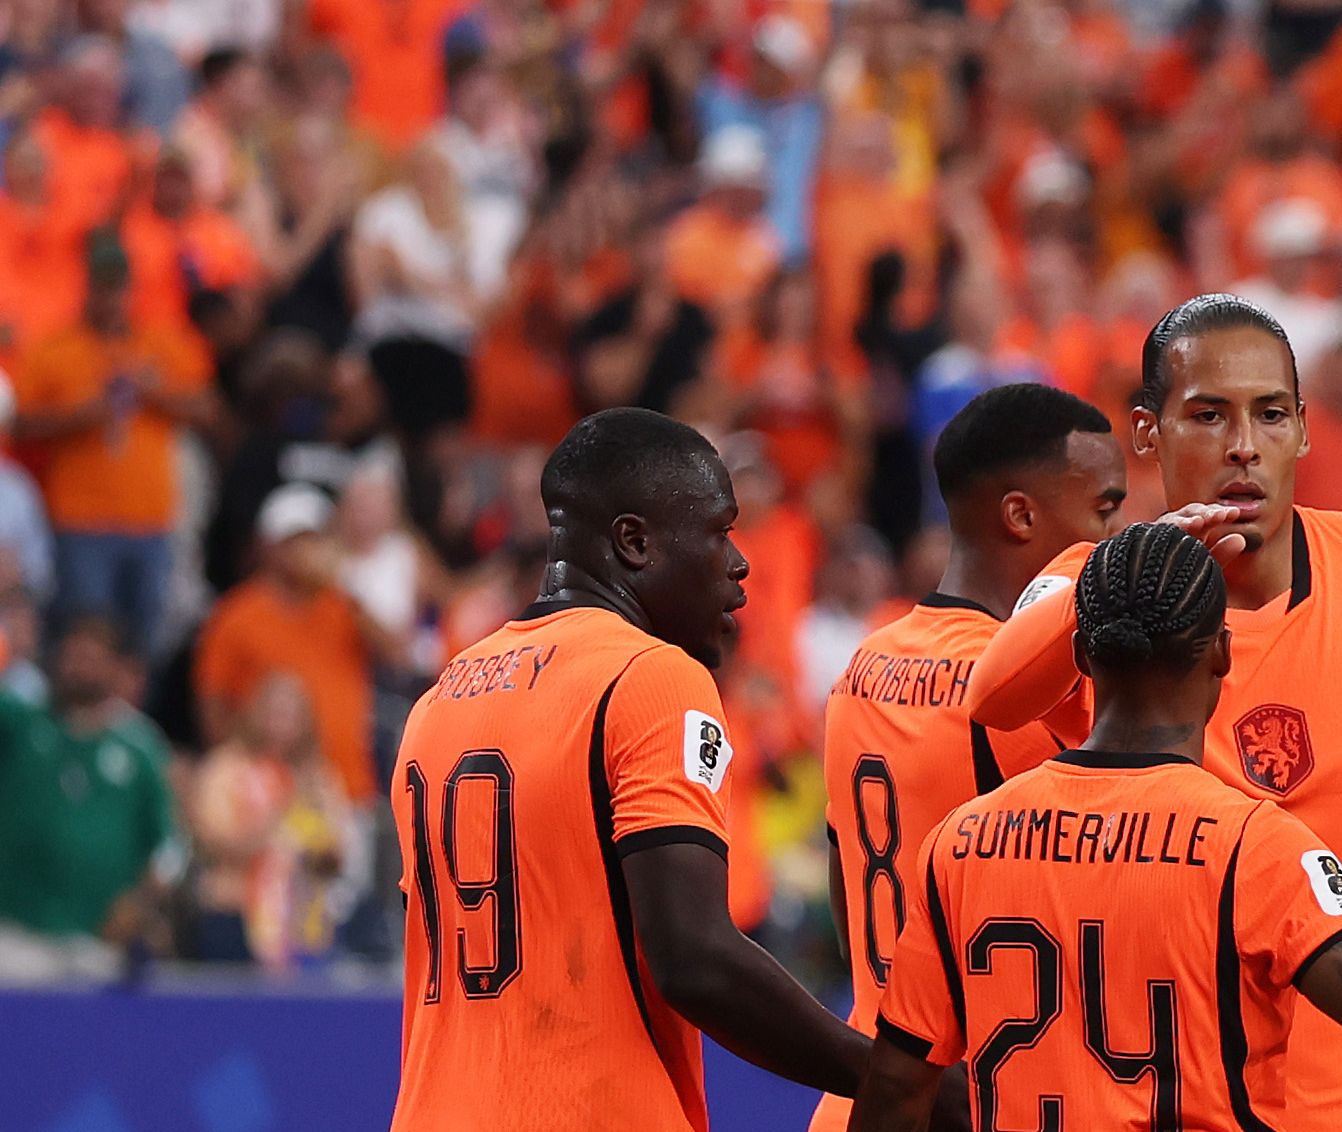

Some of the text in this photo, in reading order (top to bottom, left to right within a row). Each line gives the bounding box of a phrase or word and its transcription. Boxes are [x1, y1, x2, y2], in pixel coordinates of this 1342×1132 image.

[405, 748, 522, 1005] 19
[852, 753, 906, 989] 8
[952, 808, 1218, 867] SUMMERVILLE
